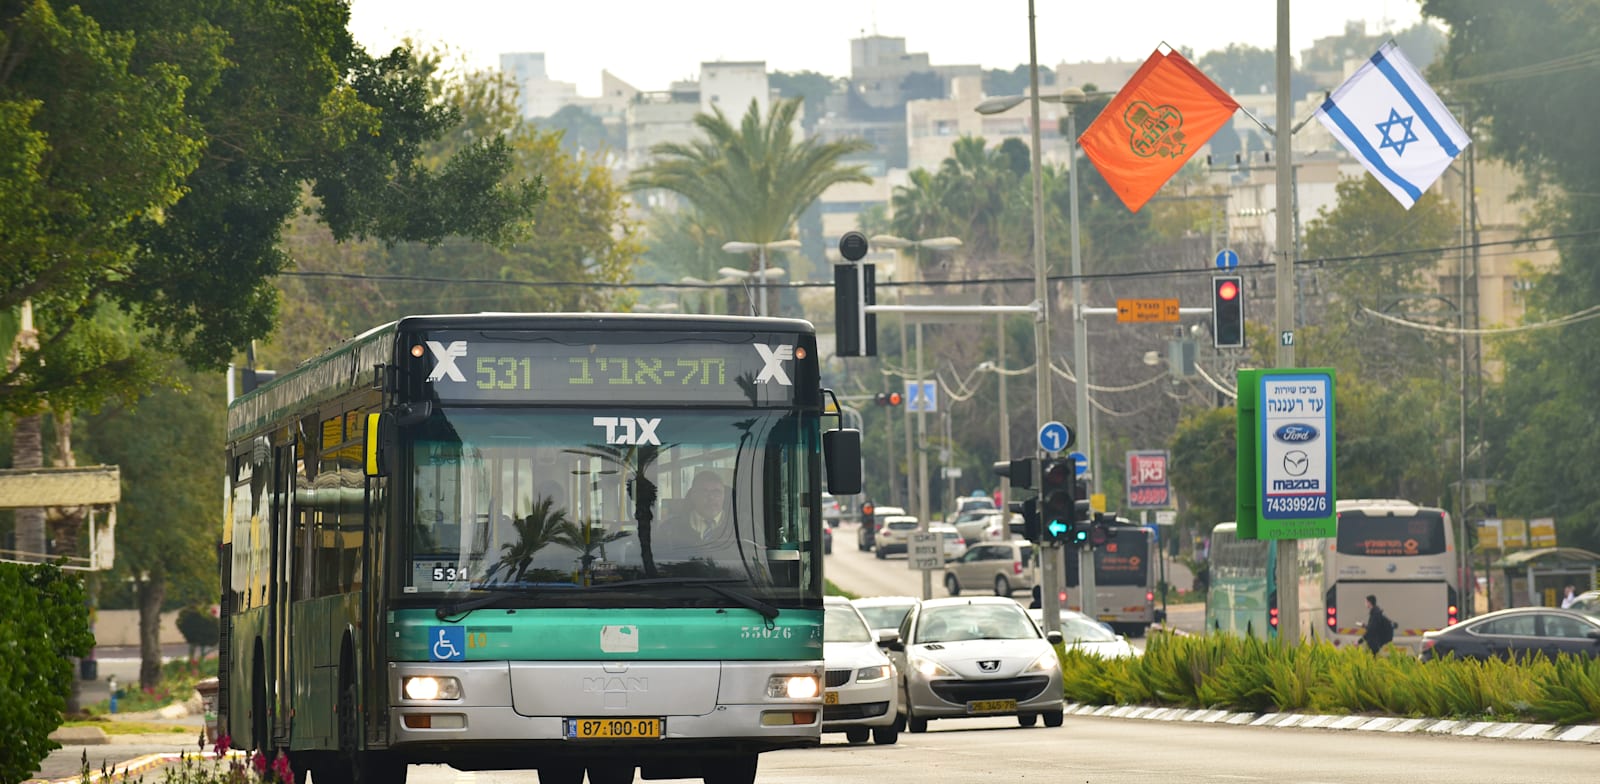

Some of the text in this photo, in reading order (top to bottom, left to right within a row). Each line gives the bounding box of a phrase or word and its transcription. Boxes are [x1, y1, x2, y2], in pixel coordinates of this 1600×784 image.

[1167, 306, 1177, 316] 12
[1282, 332, 1293, 345] 17
[476, 356, 531, 390] 531
[568, 357, 725, 385] תל-אביב
[1274, 385, 1297, 395] שירות
[1268, 398, 1324, 413] עד רעננה
[593, 416, 662, 446] אגד
[1283, 426, 1310, 441] Ford
[1273, 479, 1319, 491] mazda
[1267, 497, 1327, 513] 7433992/6
[433, 567, 468, 581] 531
[583, 677, 649, 692] MAN
